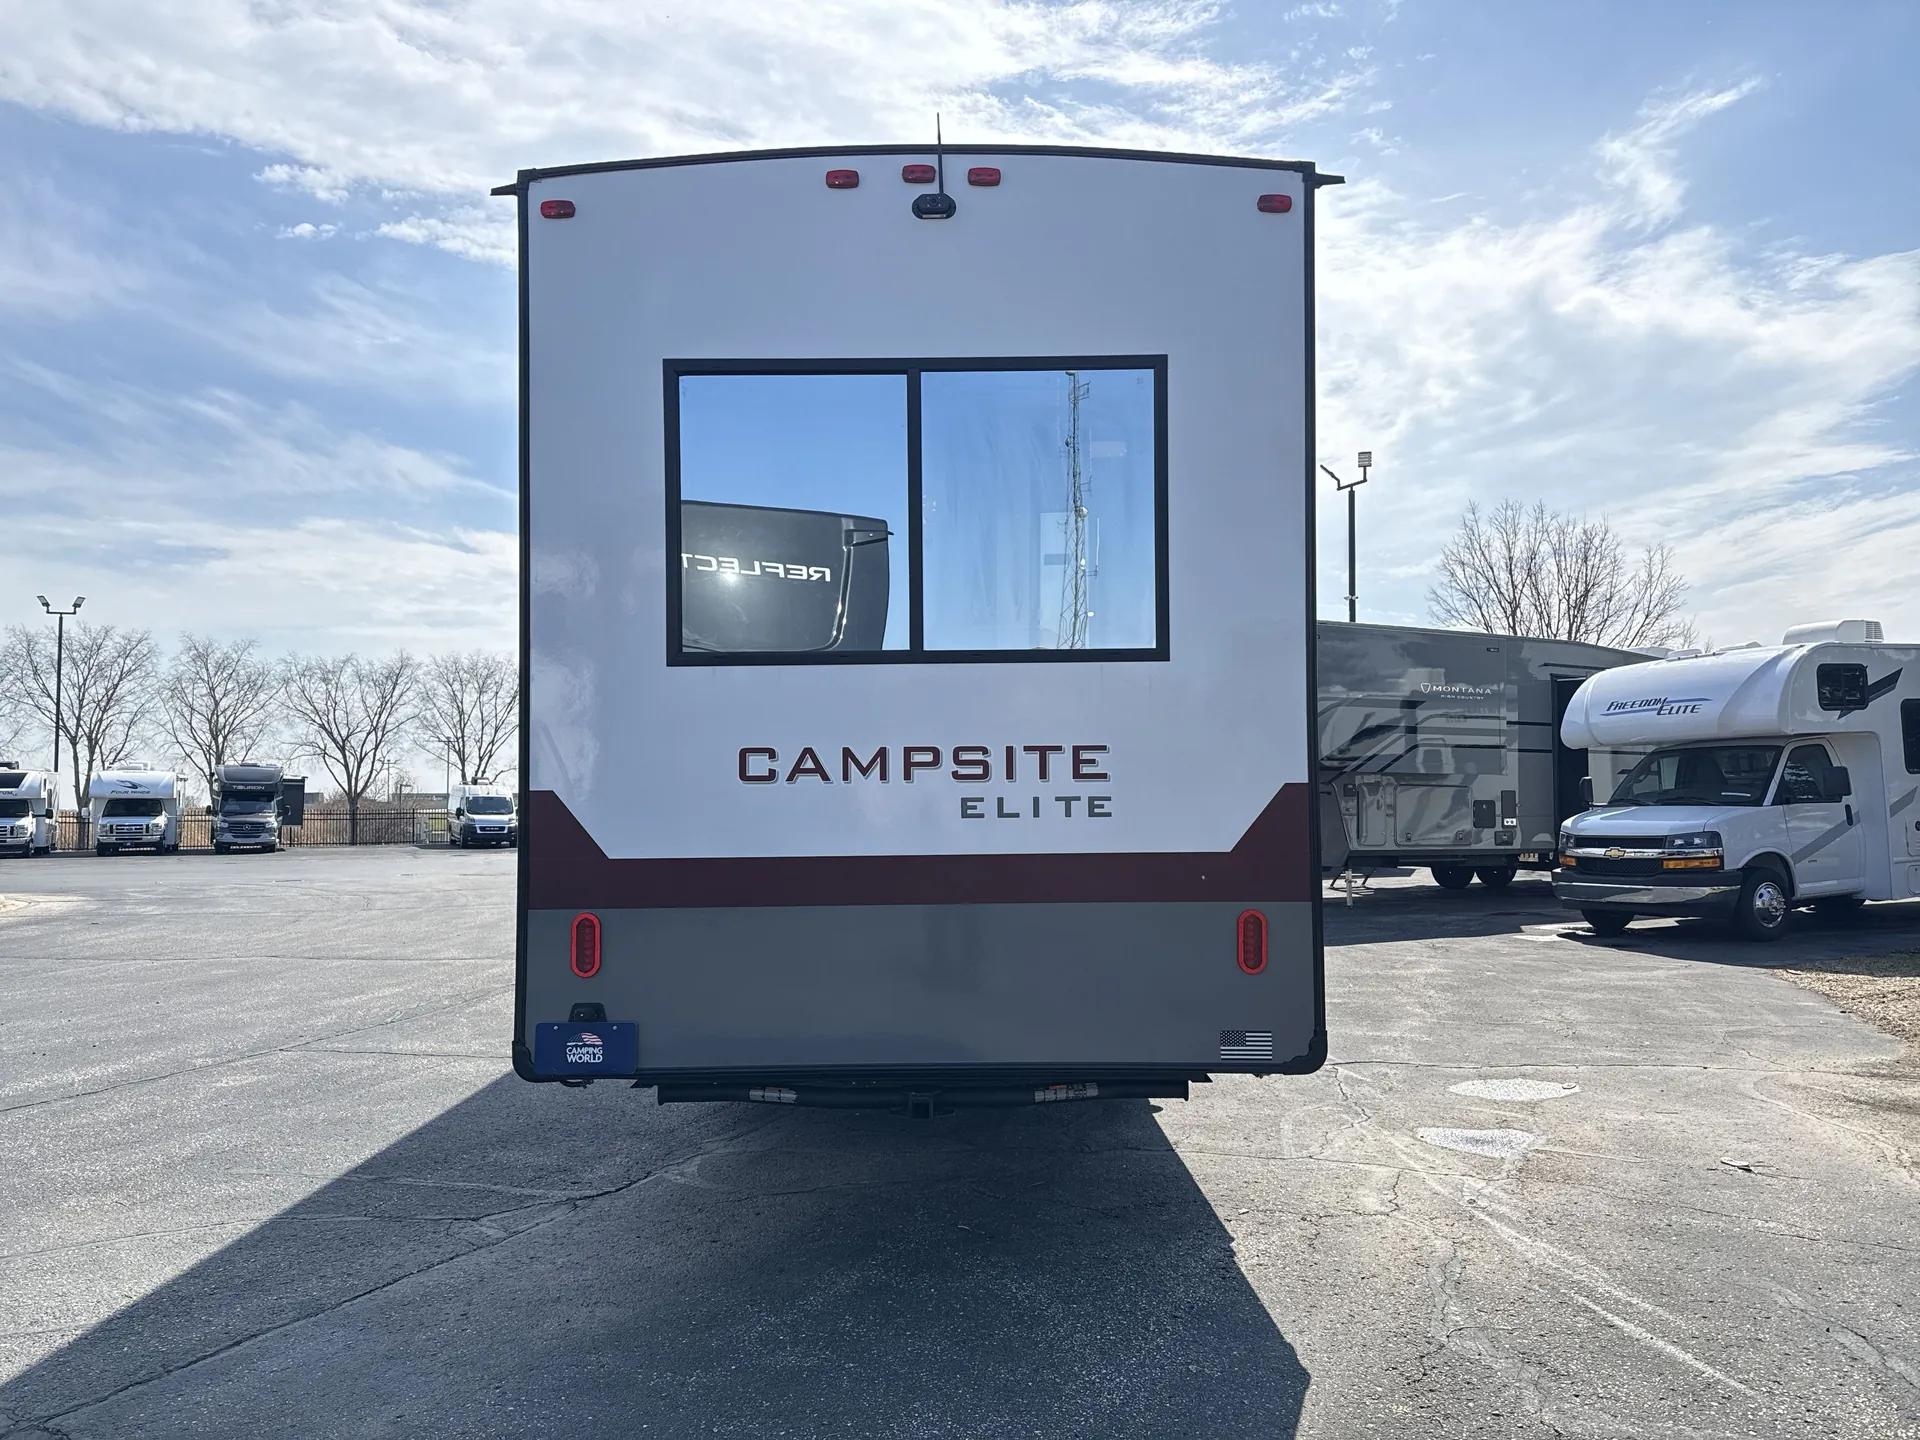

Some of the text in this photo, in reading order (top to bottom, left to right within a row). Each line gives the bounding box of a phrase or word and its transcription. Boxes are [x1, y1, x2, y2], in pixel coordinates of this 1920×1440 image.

[1433, 685, 1492, 694] MONTANA
[1606, 697, 1668, 712] FREEDOM
[1656, 704, 1703, 716] ELITE
[738, 744, 1111, 783] CAMPSITE
[961, 796, 1112, 818] ELITE
[566, 1046, 603, 1055] CAMPING
[566, 1054, 603, 1063] WORLD
